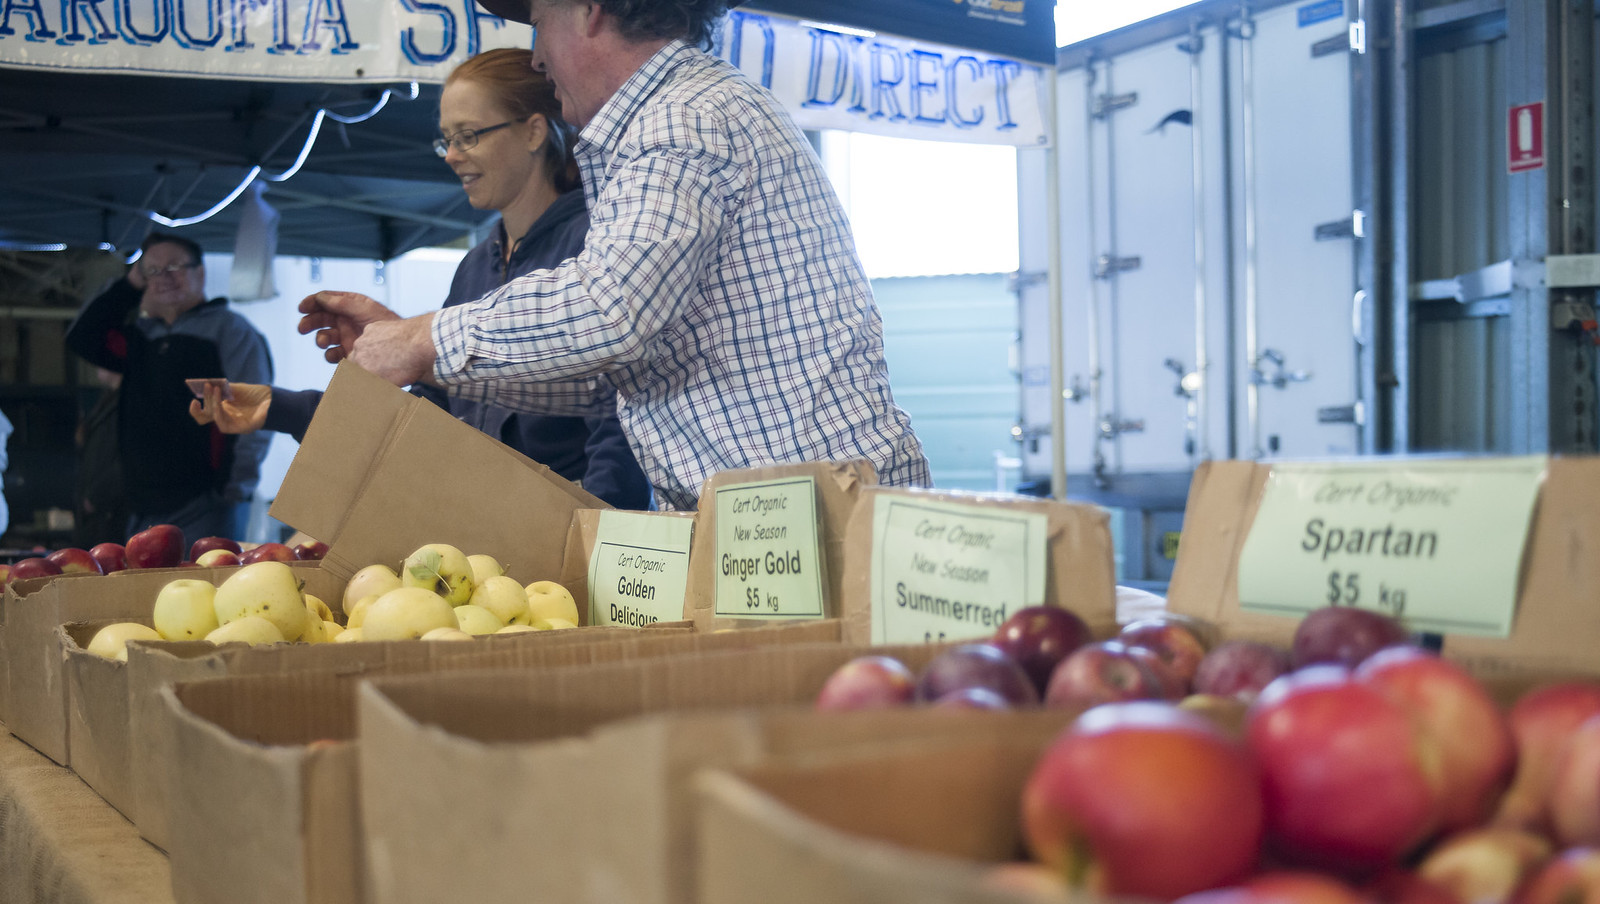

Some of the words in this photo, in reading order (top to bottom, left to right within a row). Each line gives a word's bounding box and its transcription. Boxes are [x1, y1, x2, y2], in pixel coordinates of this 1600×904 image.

[801, 28, 1022, 131] DIRECT
[732, 496, 751, 514] Cert
[752, 493, 787, 515] Organic
[1314, 481, 1364, 504] Cert
[1367, 482, 1457, 511] Organic
[733, 526, 752, 541] New
[753, 525, 787, 540] Season
[914, 520, 944, 538] Cert
[947, 526, 994, 551] Organic
[1301, 518, 1438, 560] Spartan
[618, 553, 634, 567] Cert
[634, 554, 666, 574] Organic
[721, 553, 760, 582] Ginger
[764, 550, 801, 575] Gold
[911, 552, 937, 574] New
[941, 560, 990, 584] Season
[617, 576, 656, 600] Golden
[746, 588, 760, 608] $5
[767, 593, 779, 612] kg
[1326, 571, 1360, 606] $5
[1378, 583, 1407, 613] kg
[896, 582, 1007, 627] Summerred
